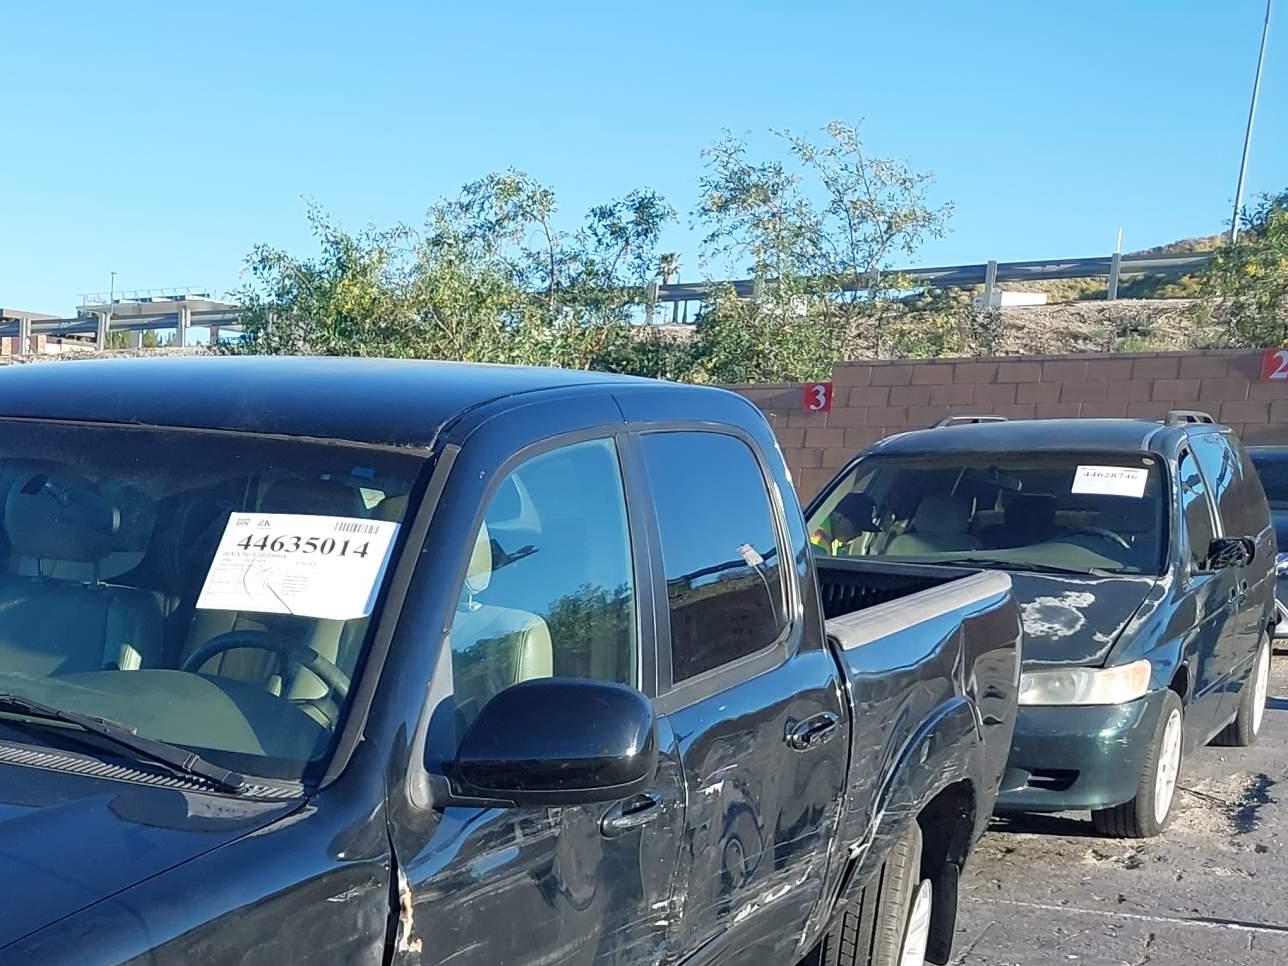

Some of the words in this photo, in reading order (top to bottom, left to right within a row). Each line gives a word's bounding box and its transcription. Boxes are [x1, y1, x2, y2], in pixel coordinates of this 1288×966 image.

[1269, 350, 1288, 379] 2
[809, 385, 826, 410] 3
[236, 533, 370, 558] 44635014
